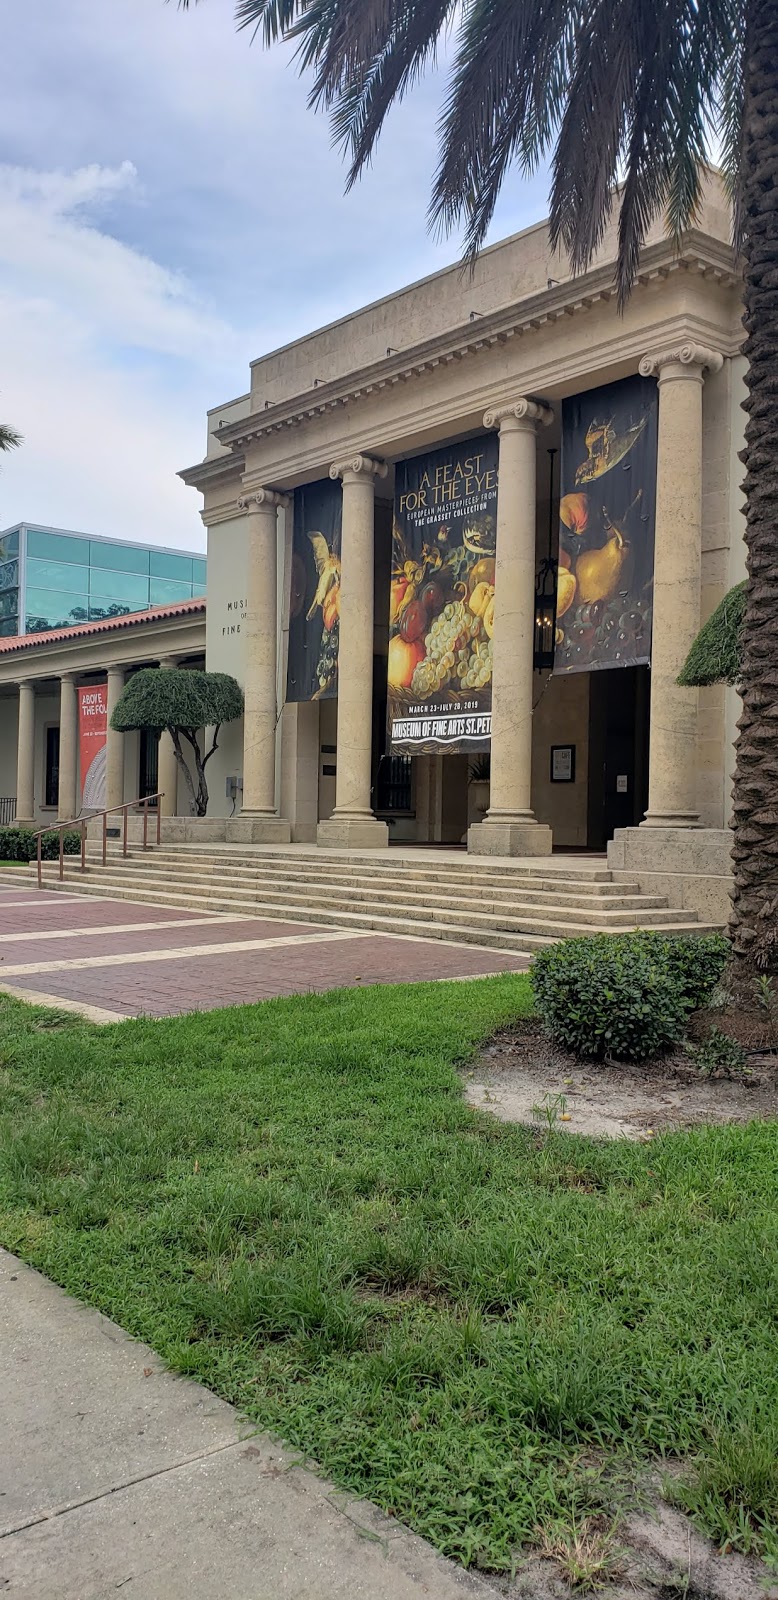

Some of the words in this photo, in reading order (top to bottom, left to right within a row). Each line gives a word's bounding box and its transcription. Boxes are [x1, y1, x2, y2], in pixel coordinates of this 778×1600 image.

[420, 471, 431, 489] A
[435, 454, 484, 486] FEAST
[400, 490, 428, 513] FOR
[431, 480, 461, 504] THE
[407, 507, 434, 520] EUROPEAN
[437, 496, 479, 513] MASTERPIECES
[481, 490, 497, 501] FROM
[415, 518, 425, 527] THE
[427, 512, 451, 525] GRASSET
[453, 502, 487, 518] COLLECTION
[222, 624, 241, 636] FINE
[82, 693, 102, 705] ABOVE
[409, 705, 428, 714] MARCH
[464, 701, 478, 709] 2019
[82, 705, 95, 716] THE
[392, 722, 422, 738] MUSEUM
[422, 721, 432, 737] OF
[432, 720, 448, 736] FINE
[447, 718, 465, 736] ARTS
